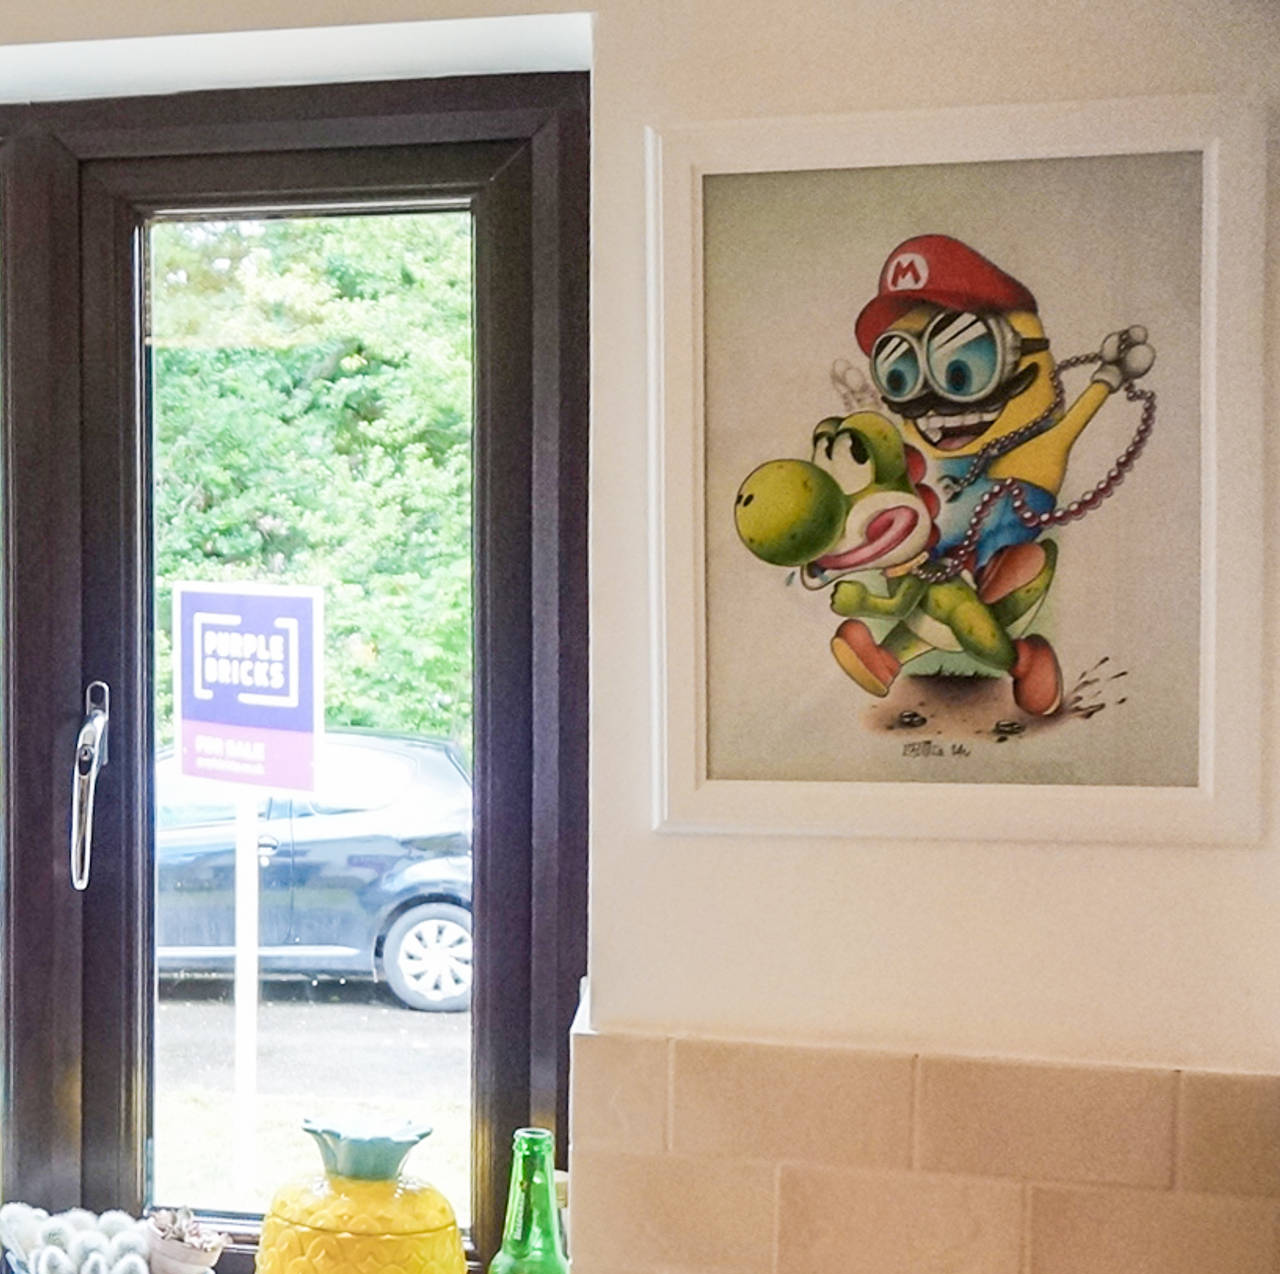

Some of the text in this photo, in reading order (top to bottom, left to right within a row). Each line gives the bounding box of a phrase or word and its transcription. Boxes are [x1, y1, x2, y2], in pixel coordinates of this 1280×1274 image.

[891, 259, 922, 288] M
[203, 630, 284, 661] PURPLE
[204, 657, 285, 689] BRICKS
[224, 738, 265, 761] SALE
